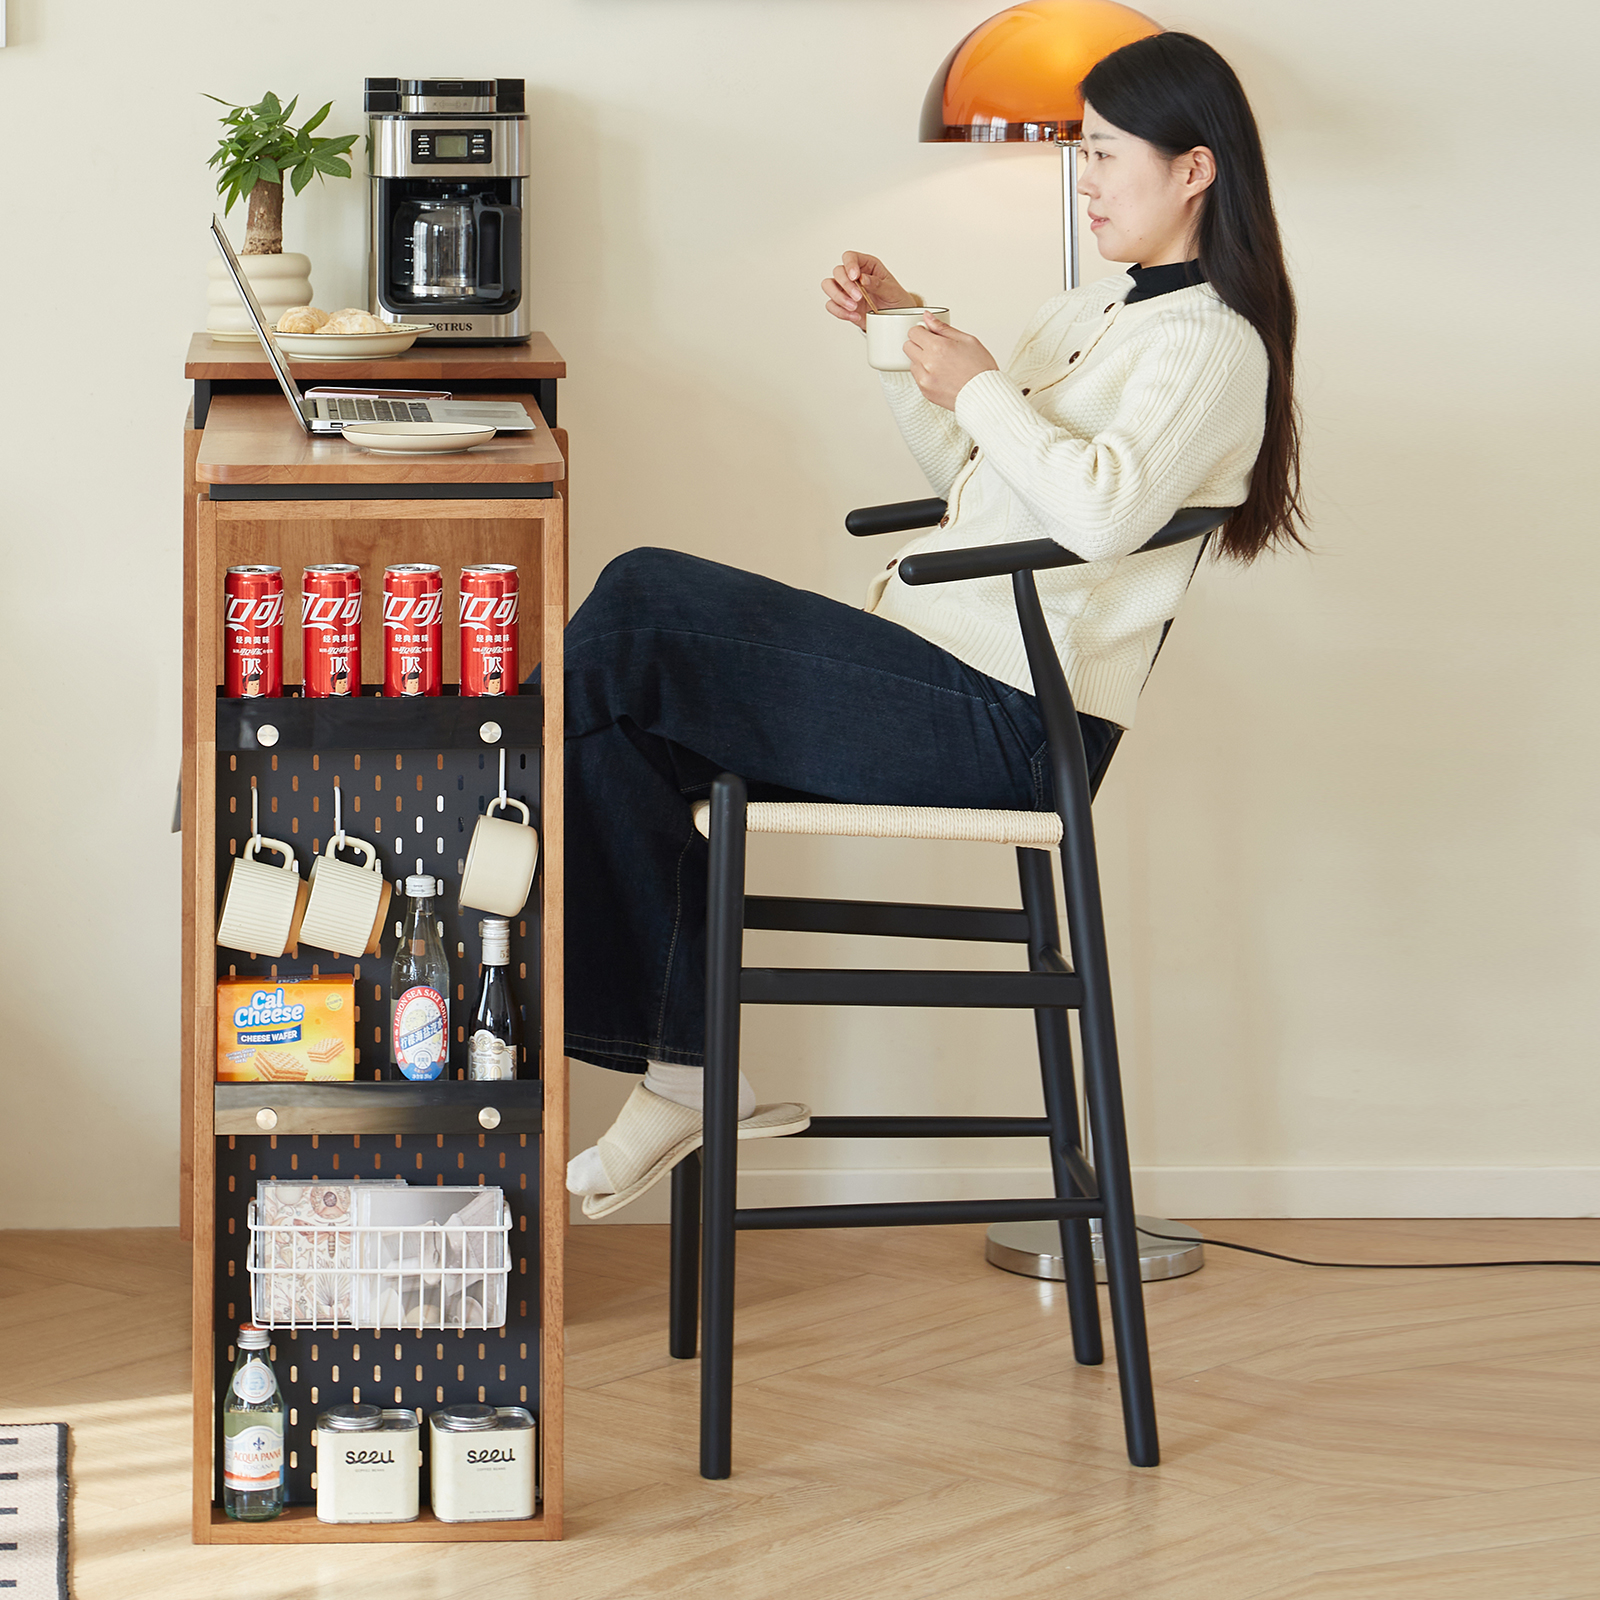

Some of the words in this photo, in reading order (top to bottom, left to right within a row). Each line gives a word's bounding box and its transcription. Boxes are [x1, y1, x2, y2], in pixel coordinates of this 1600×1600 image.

[251, 988, 284, 1011] Cal
[394, 997, 408, 1027] LEMON
[406, 989, 423, 1001] SEA
[423, 989, 441, 1003] SALT
[439, 1001, 448, 1024] SODA
[234, 1005, 304, 1027] Cheese
[240, 1033, 271, 1042] CHEESE
[271, 1030, 298, 1041] WAFER
[233, 1451, 259, 1464] ACQUA
[260, 1448, 282, 1461] PANNA
